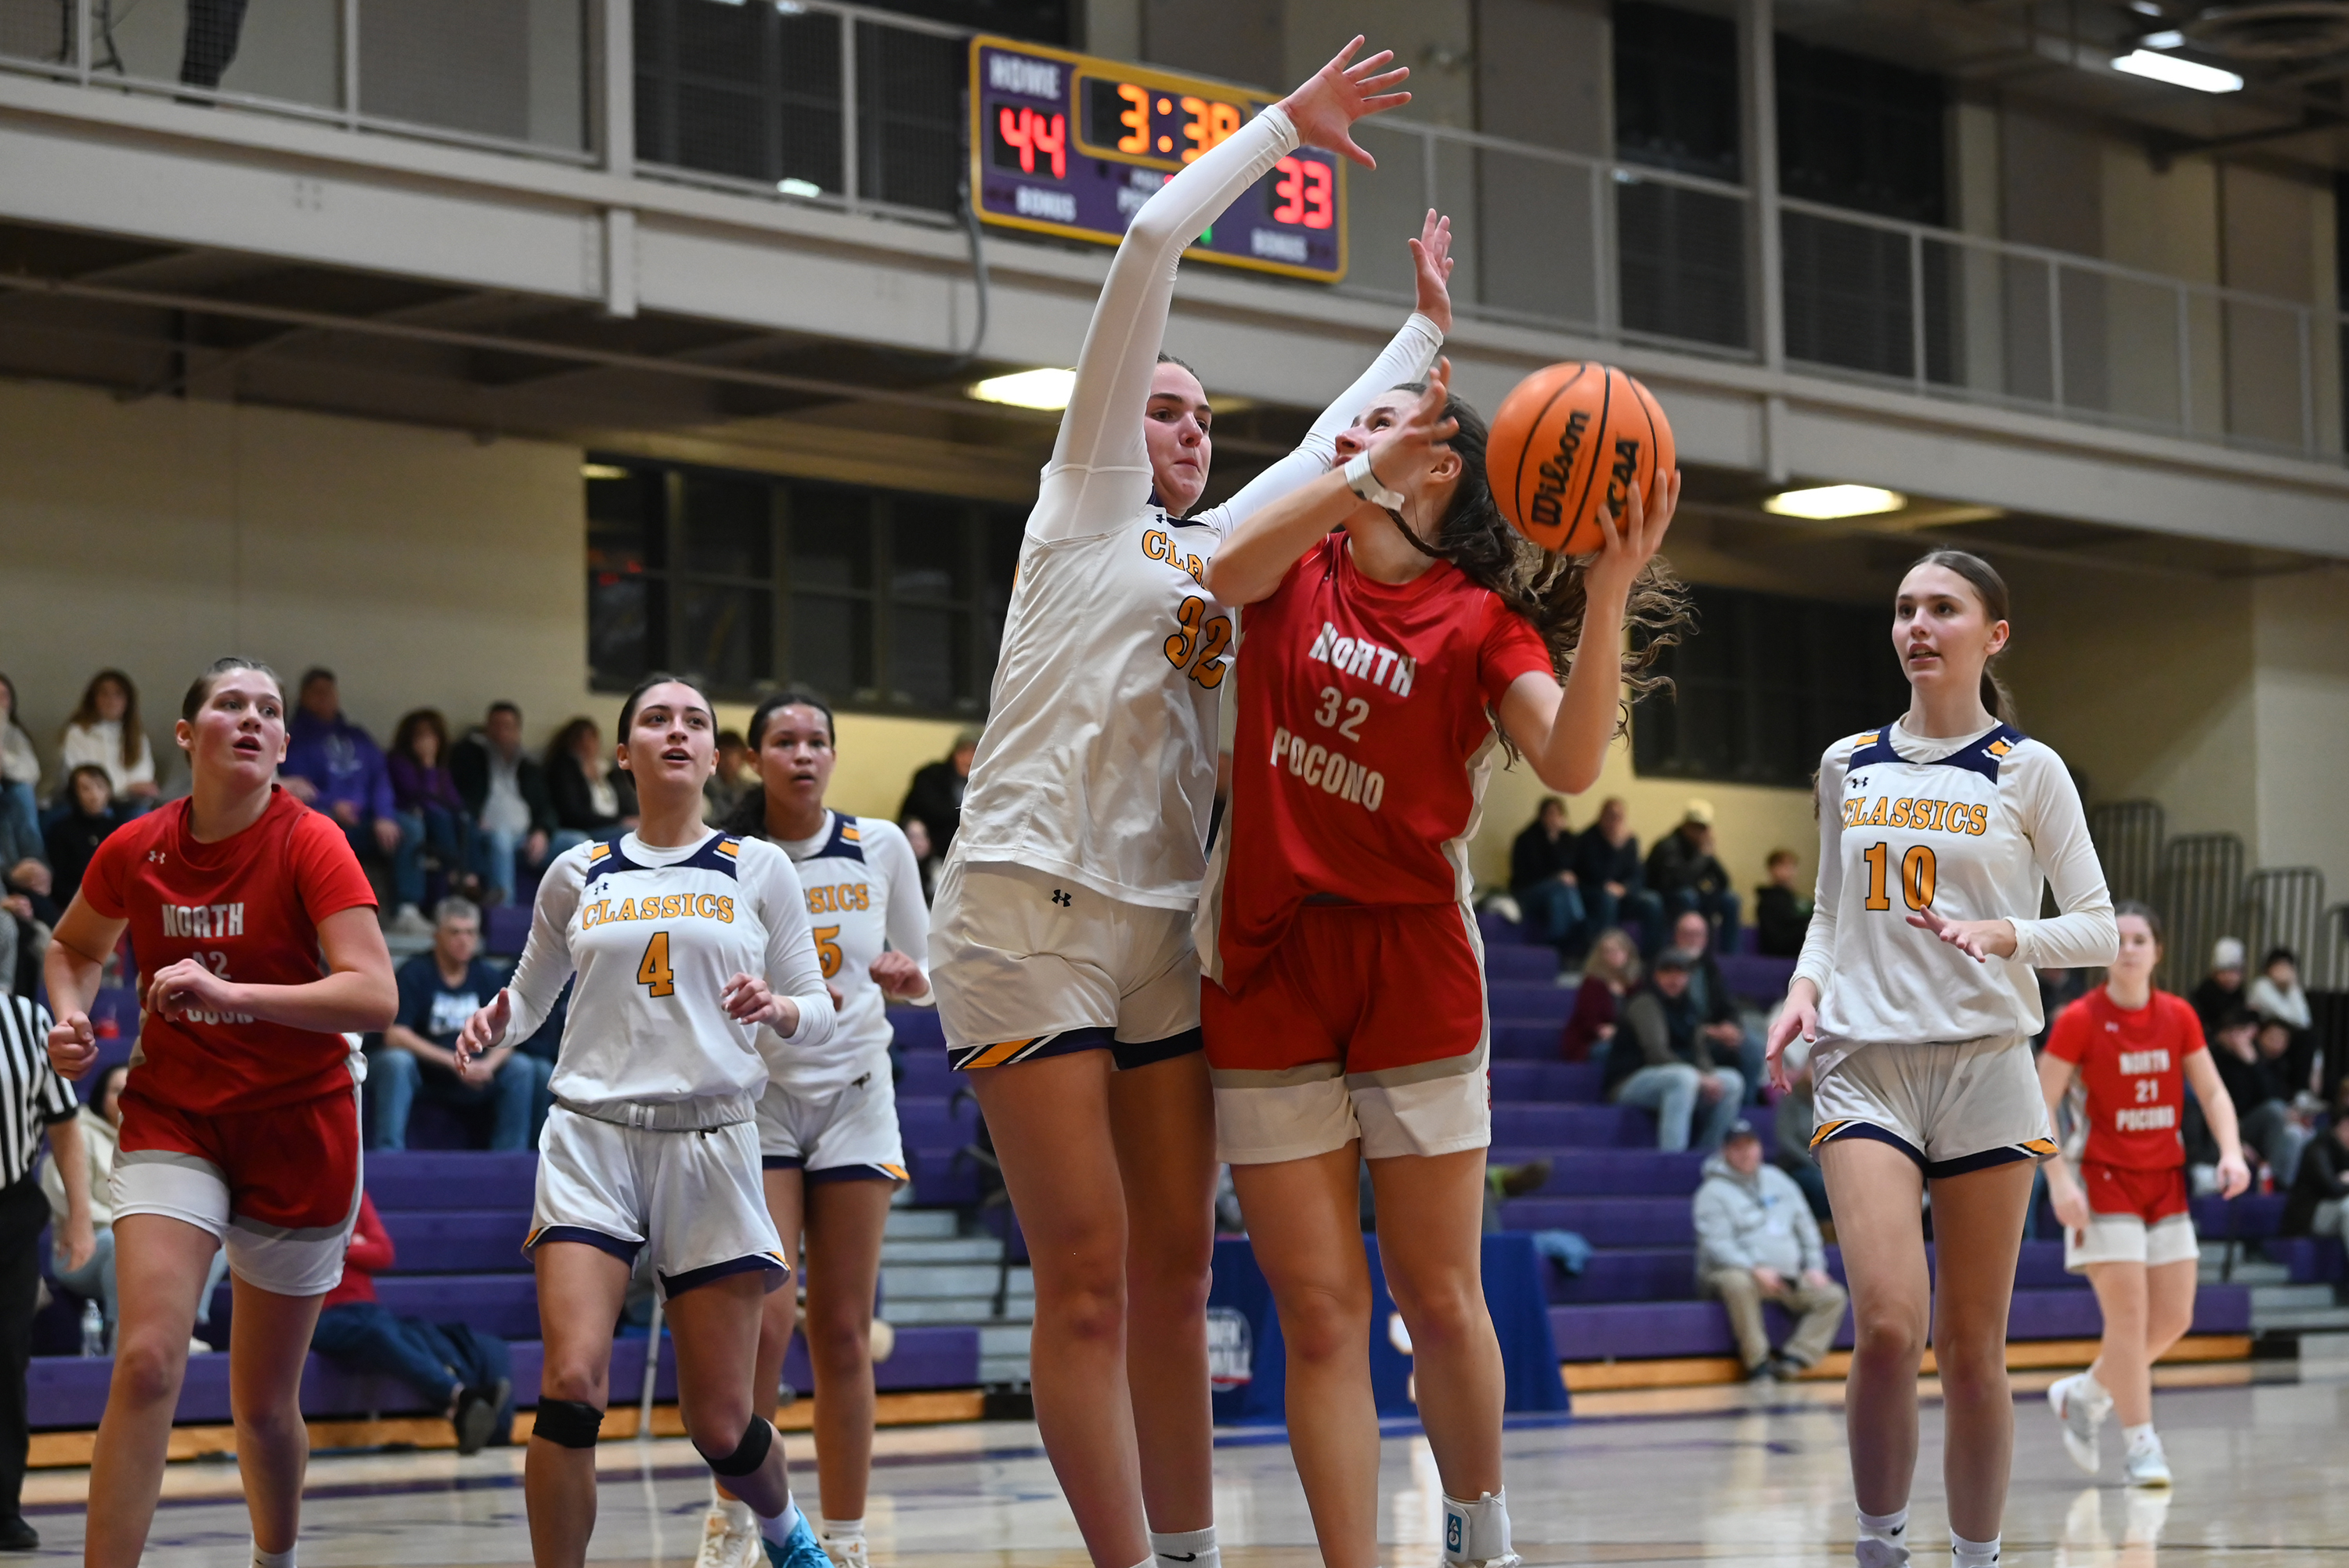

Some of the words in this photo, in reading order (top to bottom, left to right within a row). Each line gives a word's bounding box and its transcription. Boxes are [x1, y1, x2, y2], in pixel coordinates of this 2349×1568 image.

[989, 52, 1061, 100] HOME
[999, 106, 1066, 179] 44
[1273, 156, 1333, 229] 33
[1531, 409, 1590, 528] Wilson
[1593, 437, 1640, 525] CAA
[1164, 595, 1232, 689] 32
[1308, 621, 1416, 697] NORTH
[1314, 686, 1369, 743] 32
[1270, 726, 1385, 813] POCONO
[1842, 796, 1988, 836] CLASSICS
[803, 882, 870, 914] SICS
[1864, 842, 1936, 911] 10
[161, 902, 244, 938] NORTH
[582, 892, 734, 931] CLASSICS
[637, 931, 675, 998] 4
[2134, 1079, 2159, 1103] 21
